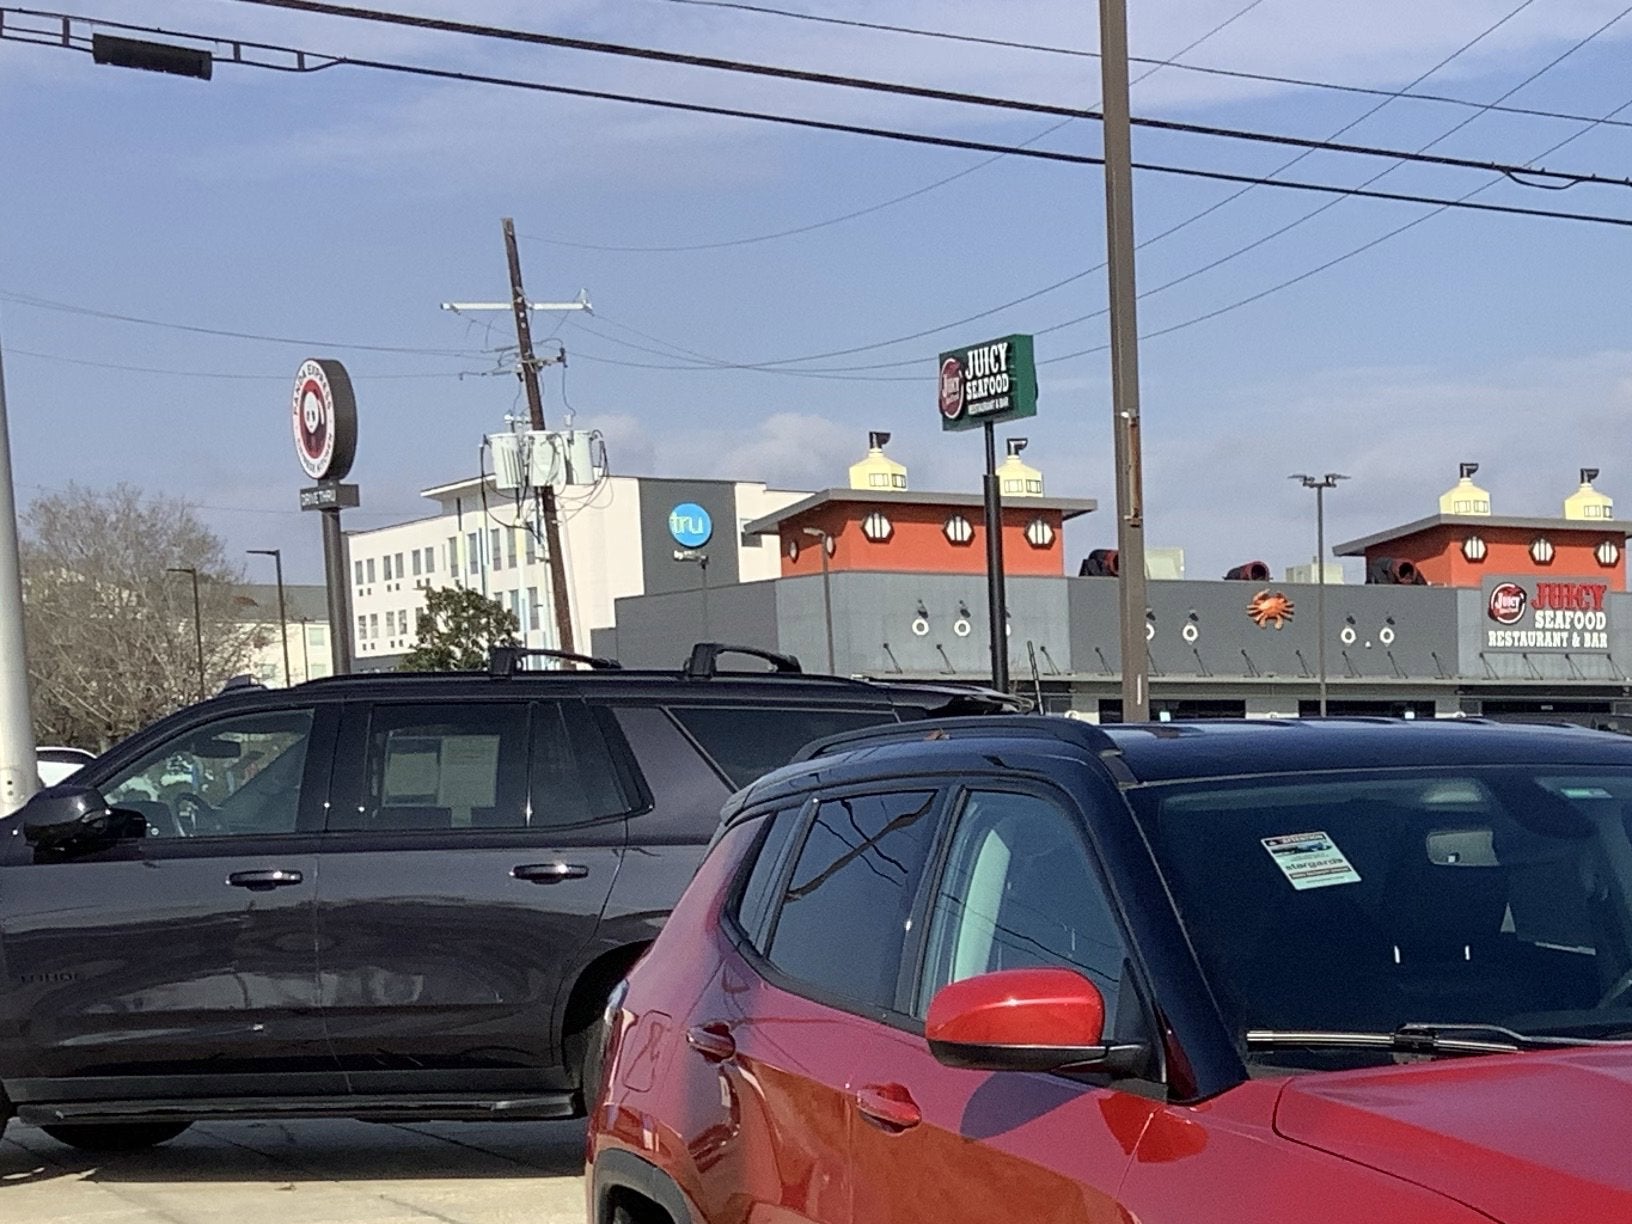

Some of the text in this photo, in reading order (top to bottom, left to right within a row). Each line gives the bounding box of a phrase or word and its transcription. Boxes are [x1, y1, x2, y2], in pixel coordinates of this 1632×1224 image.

[965, 342, 1008, 379] JUICY
[966, 373, 1009, 400] SEAFOOD
[669, 511, 704, 534] tru
[1531, 583, 1607, 610] JUICY
[1535, 611, 1607, 630] SEAFOOD
[1488, 630, 1608, 648] RESTAURANT & BAR
